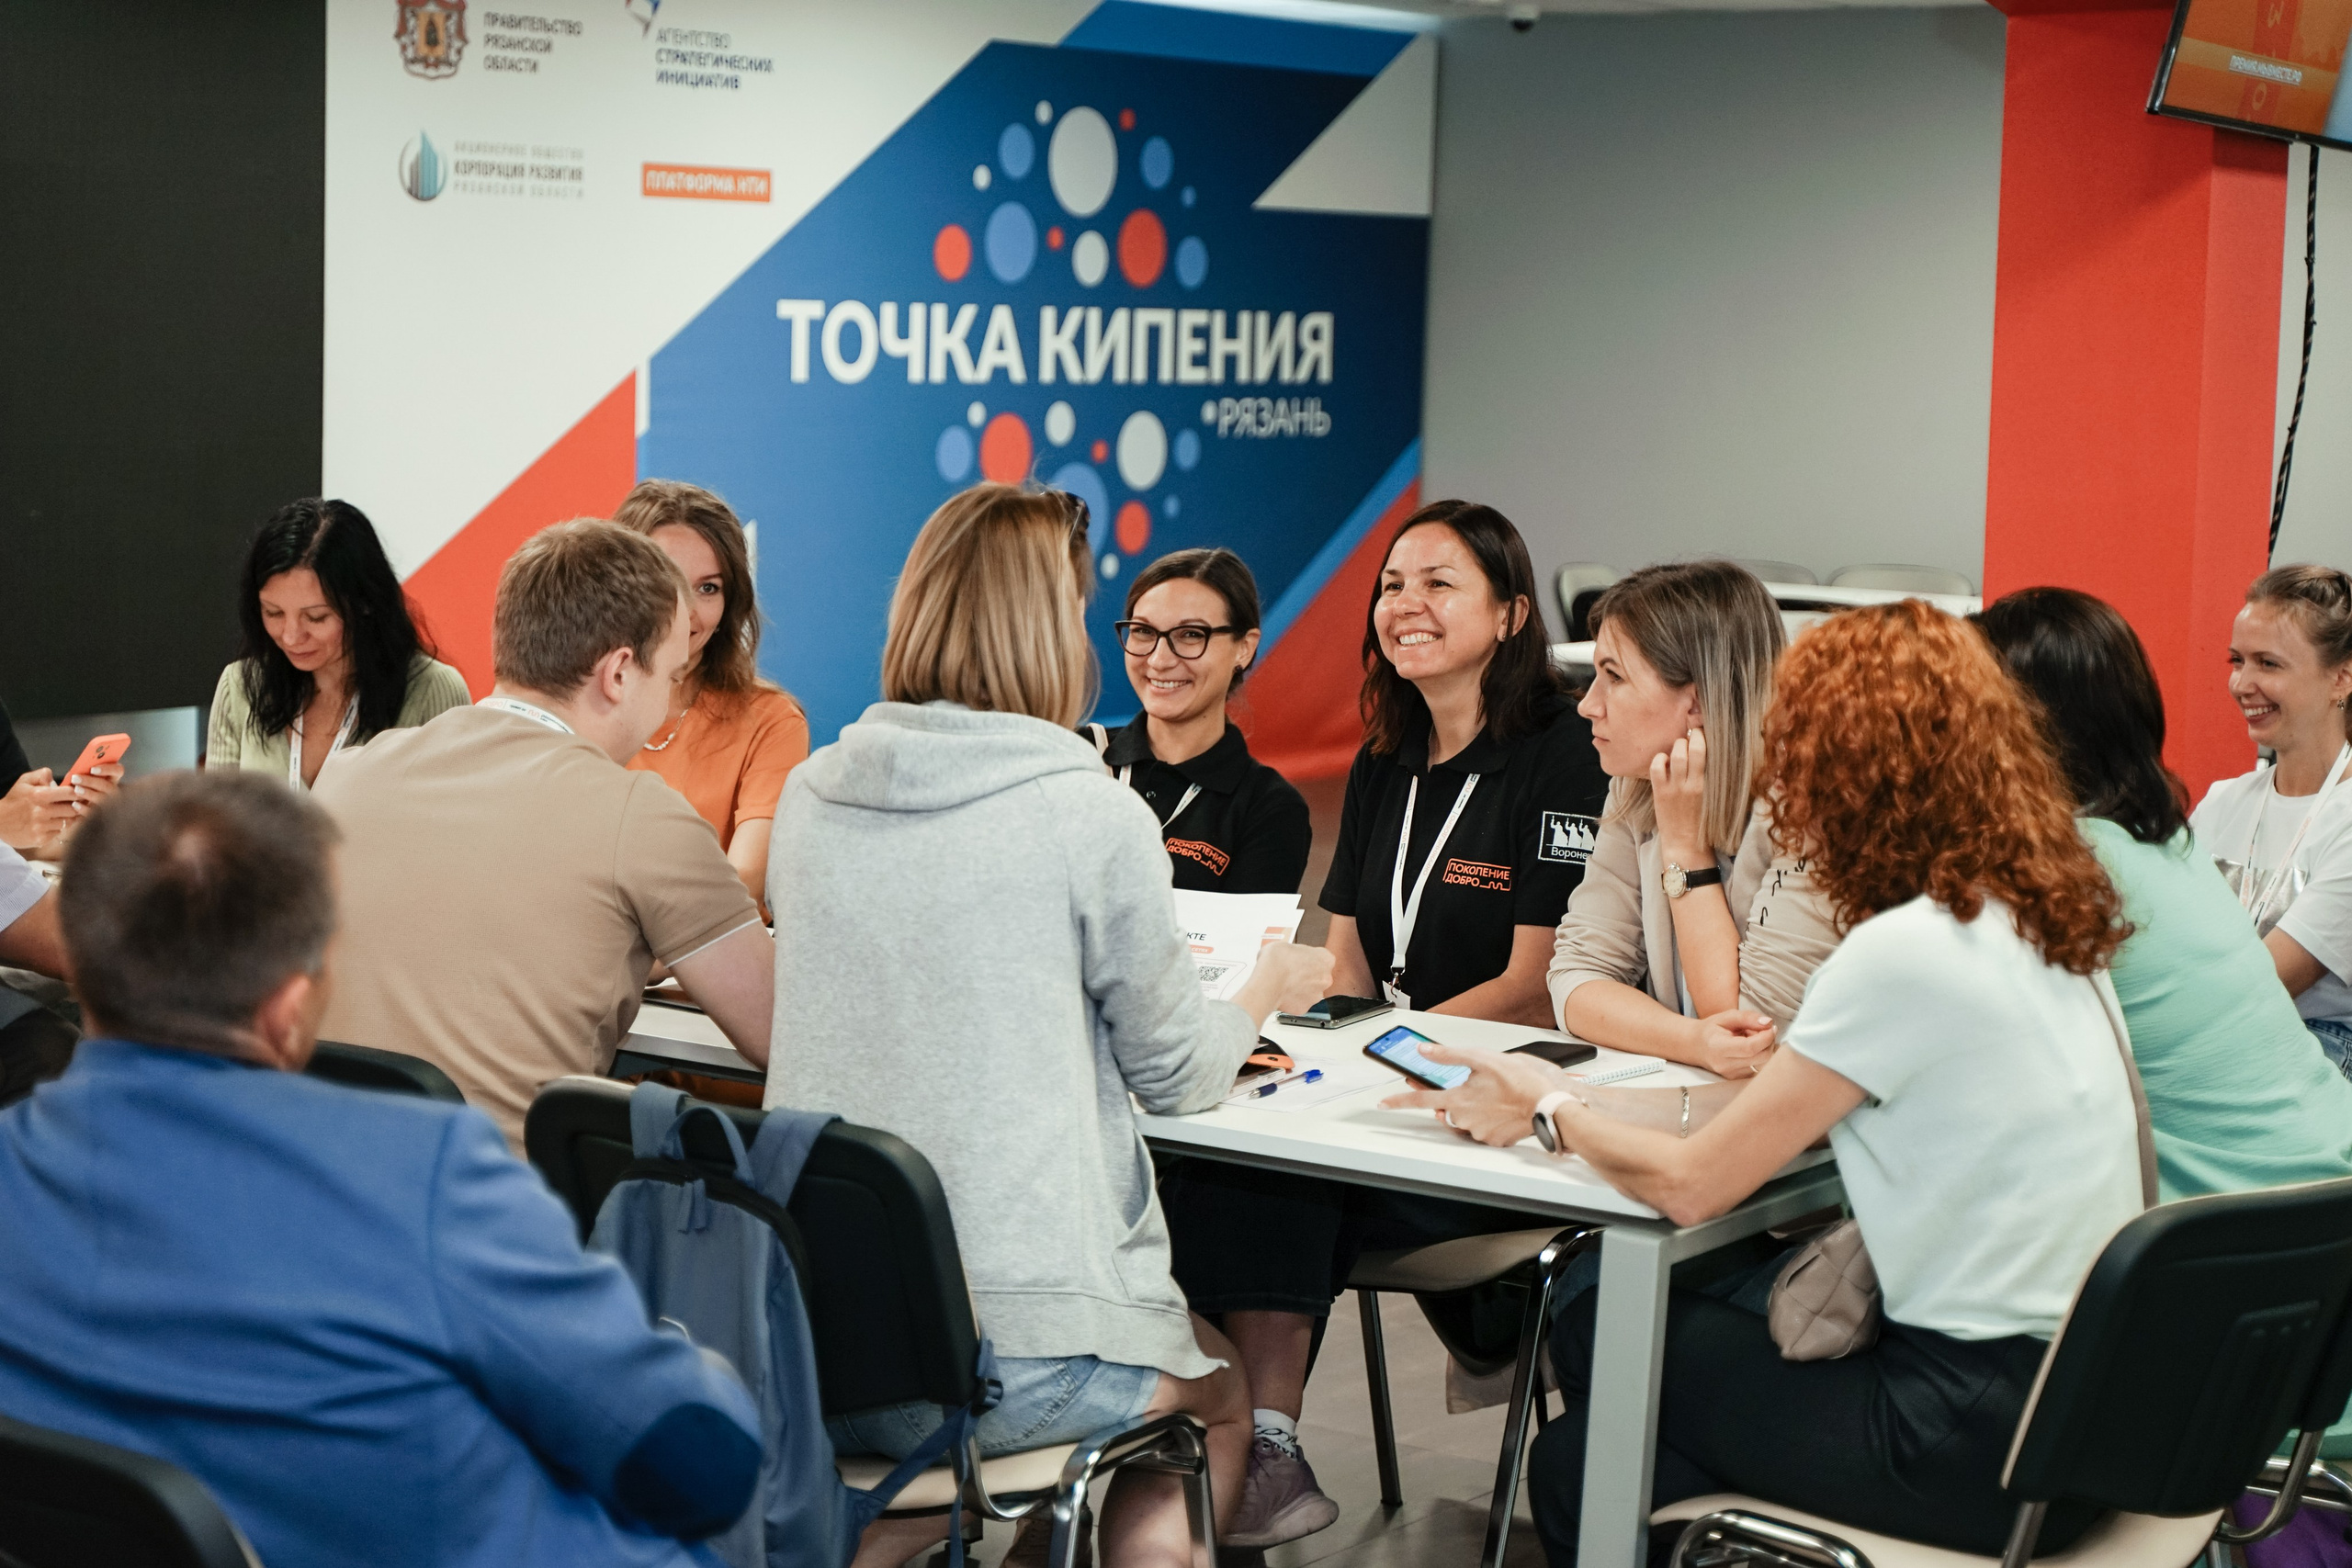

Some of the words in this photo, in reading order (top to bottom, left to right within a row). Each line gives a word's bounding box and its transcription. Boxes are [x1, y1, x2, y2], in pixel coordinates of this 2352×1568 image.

[483, 11, 583, 37] ПРАВИТЕЛЬСТВО
[483, 33, 553, 54] РЯЗАНСКОЙ
[656, 28, 731, 50] АГЕНТСТВО
[483, 55, 538, 73] ОБЛАСТИ
[655, 48, 775, 73] СТРАТЕГИЧЕСКИХ
[656, 70, 741, 90] ИНИЦИАТИВ
[454, 160, 525, 179] КОРПОРАЦИЯ
[528, 164, 582, 183] РАЗВИТИЯ
[646, 170, 734, 195] ПЛАТФОРМА
[776, 299, 1027, 385] ТОЧКА
[1038, 305, 1335, 385] КИПЕНИЯ
[1217, 397, 1331, 438] РЯЗАНЬ
[1167, 845, 1202, 861] ДОБРО
[1170, 840, 1227, 866] ПОКОЛЕНИЕ
[1551, 846, 1592, 860] Вороне
[1444, 873, 1480, 886] ДОБРО
[1449, 862, 1510, 880] ПОКОЛЕНИЕ
